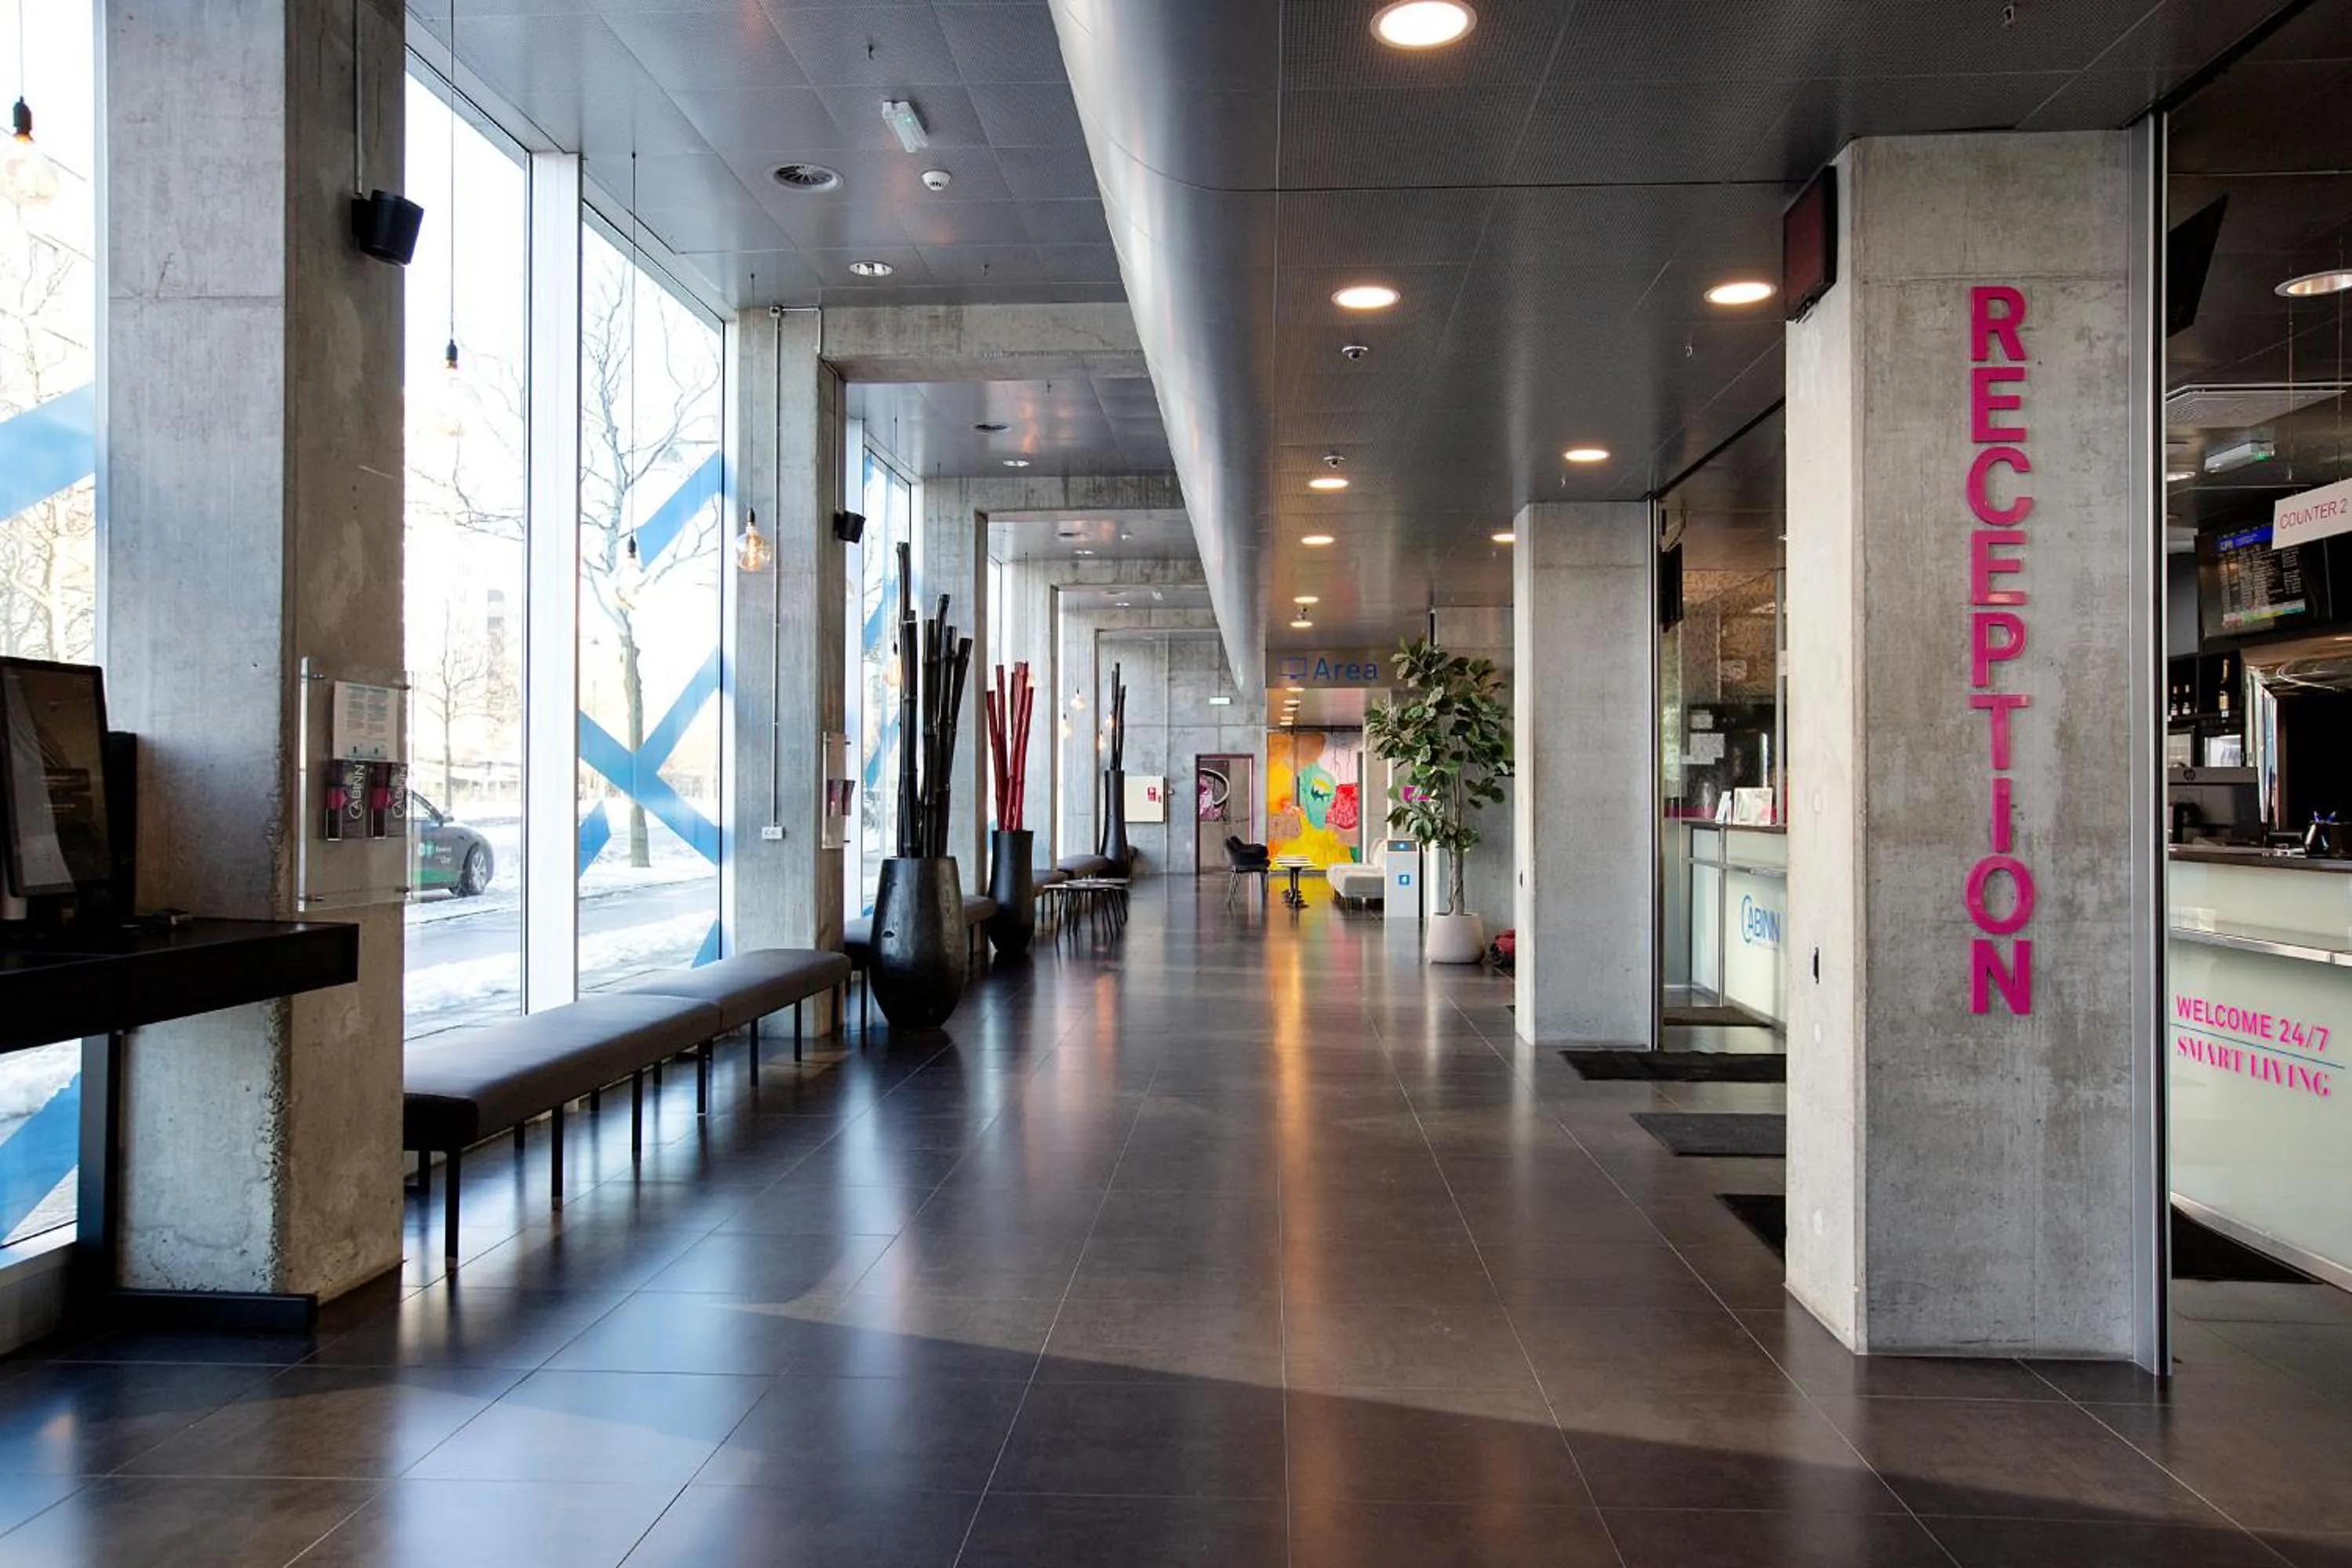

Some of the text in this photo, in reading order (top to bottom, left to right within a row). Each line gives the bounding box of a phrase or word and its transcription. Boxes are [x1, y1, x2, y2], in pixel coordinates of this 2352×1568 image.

[2280, 498, 2348, 529] COUNTER 2
[1313, 657, 1378, 680] Area
[1965, 285, 2035, 1014] RECEPTION
[349, 764, 365, 818] CABINN
[1741, 895, 1780, 943] CABINN
[2176, 994, 2329, 1052] WELCOME 24/7
[2177, 1036, 2332, 1097] SMART LIVING
